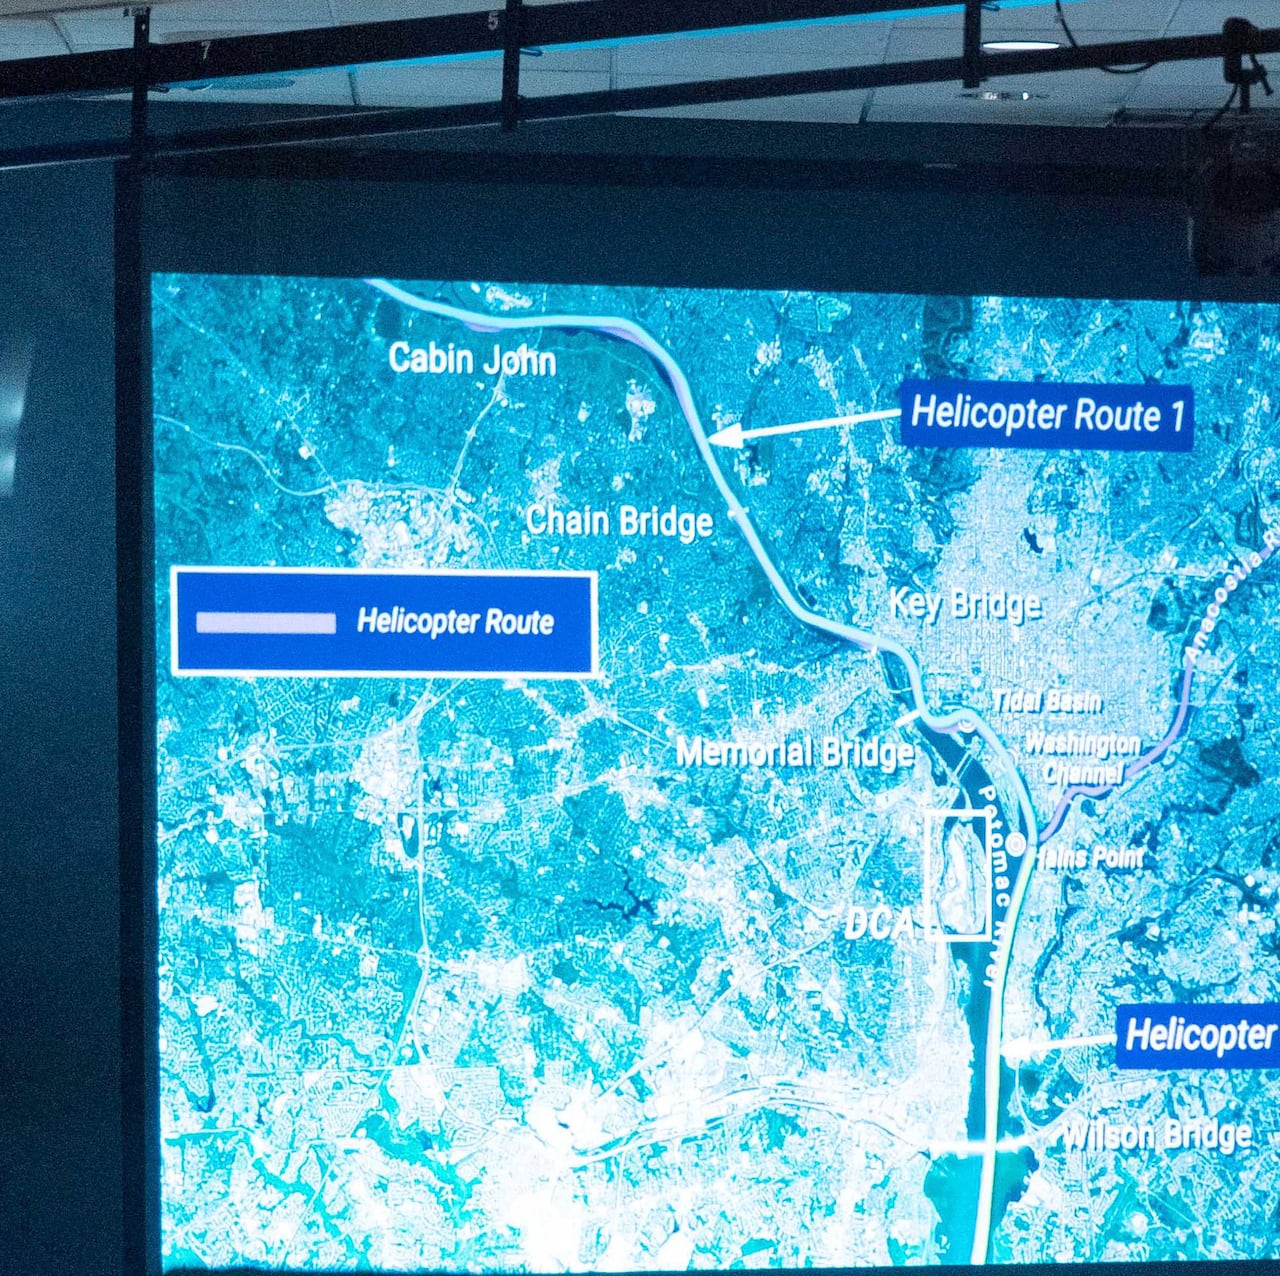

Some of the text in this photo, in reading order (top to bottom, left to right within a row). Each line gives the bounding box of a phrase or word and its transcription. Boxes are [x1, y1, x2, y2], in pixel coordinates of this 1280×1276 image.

[200, 41, 211, 60] 7
[388, 341, 557, 378] Cabin John
[911, 394, 1187, 437] Helicopter Route 1
[525, 504, 715, 543] Chain Bridge
[355, 606, 555, 639] Helicopter Route
[891, 587, 1043, 625] Key Bridge
[1185, 550, 1263, 664] Anacostia
[992, 688, 1102, 713] Tidal Basin
[676, 736, 917, 769] Memorial Bridge
[1025, 731, 1143, 760] Washington
[1044, 762, 1126, 785] Channel
[977, 784, 1011, 908] Potomac
[1092, 845, 1146, 869] Point
[844, 905, 915, 940] DCA
[1125, 1015, 1278, 1056] Helicopter
[1063, 1118, 1252, 1154] Wilson Bridge
